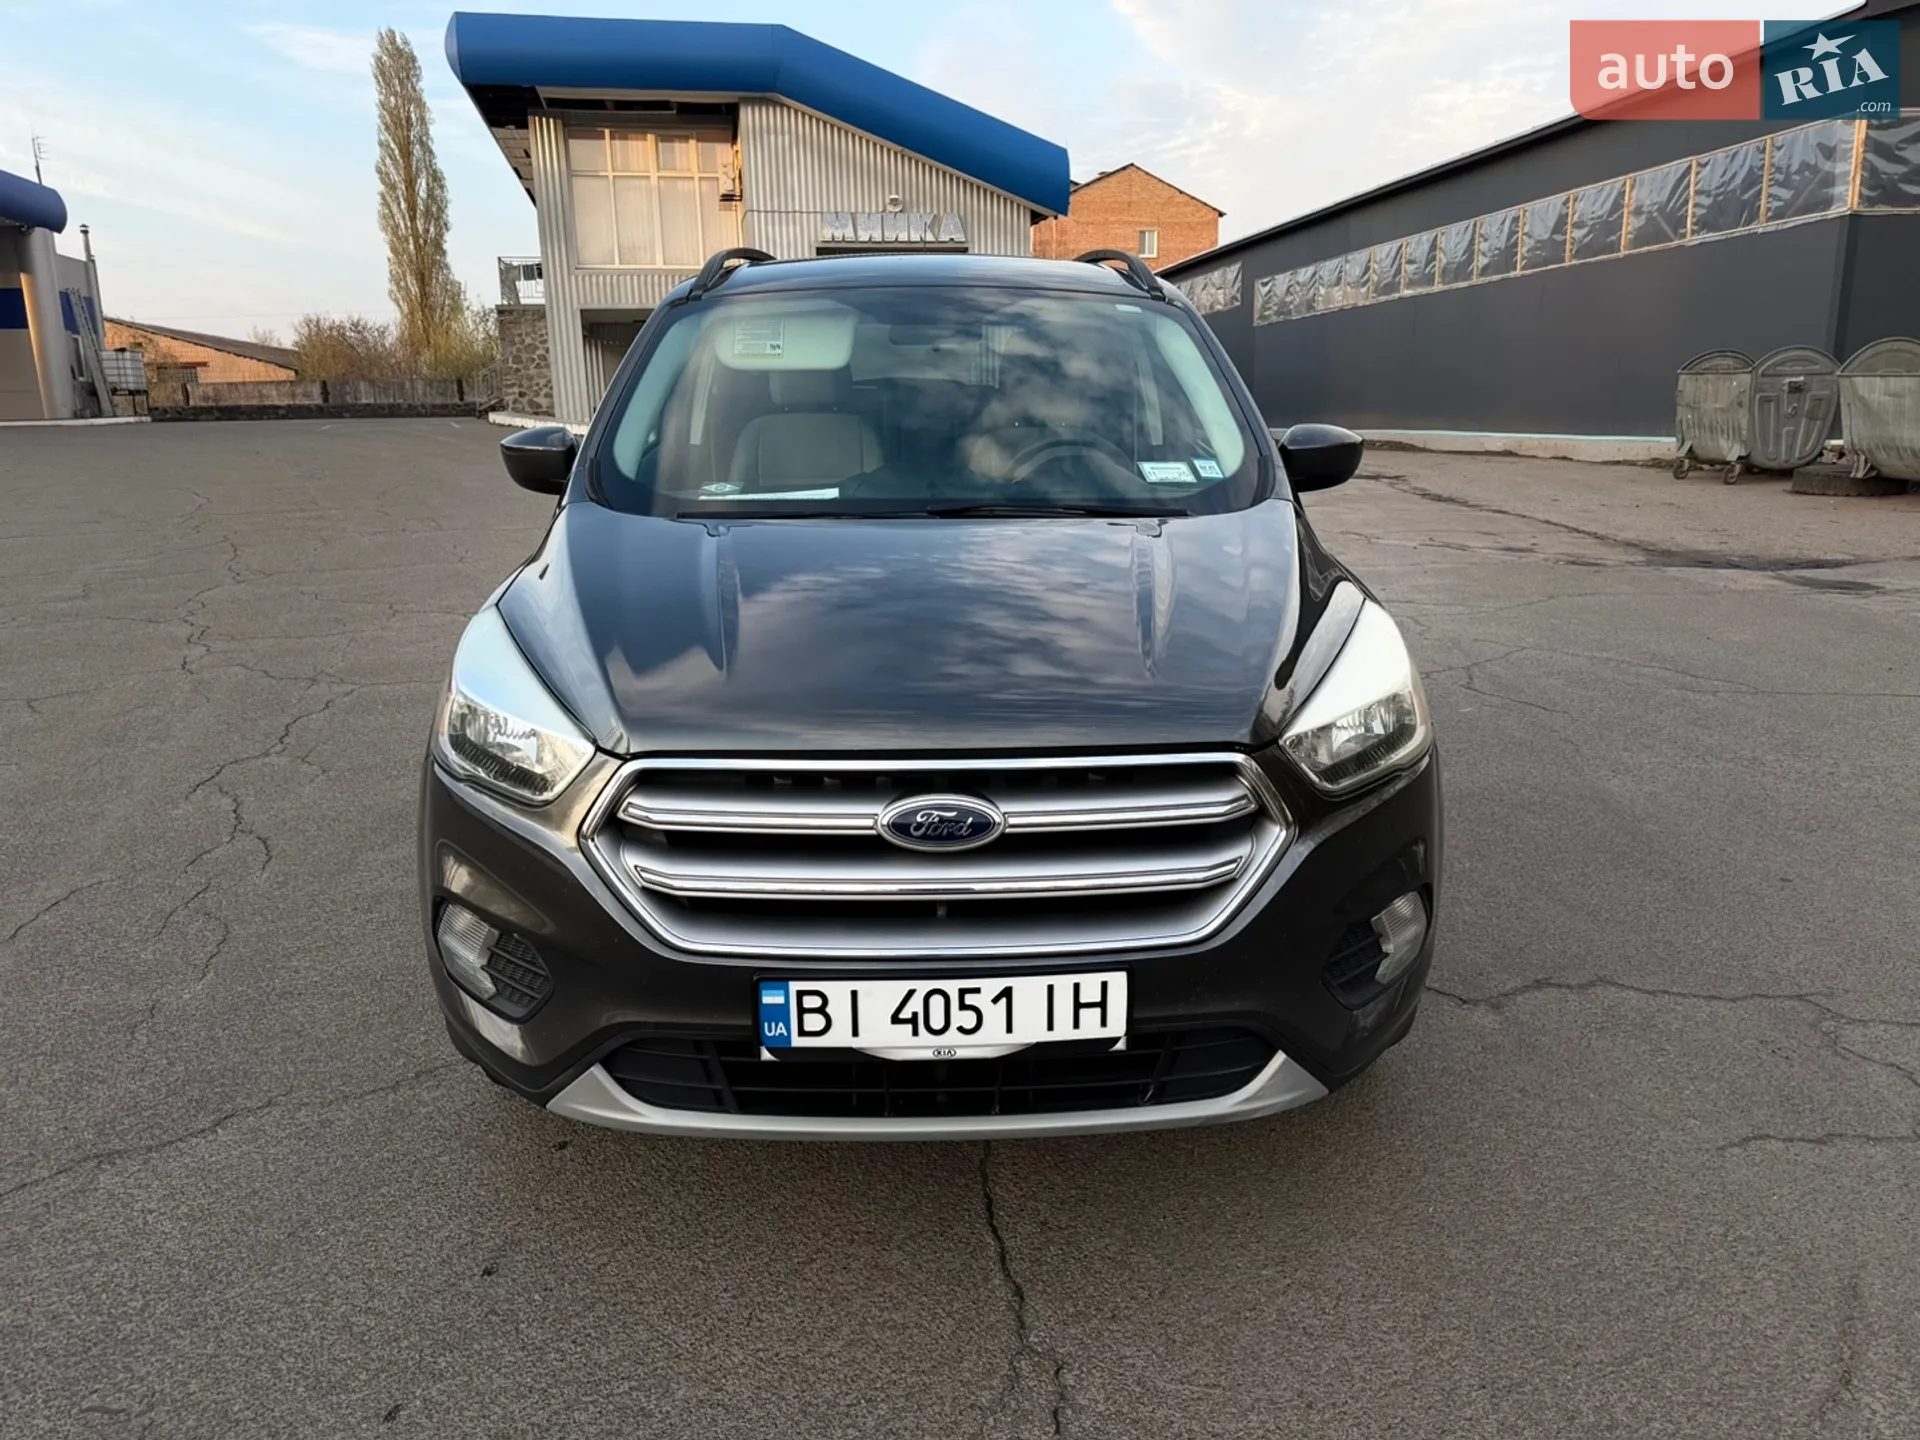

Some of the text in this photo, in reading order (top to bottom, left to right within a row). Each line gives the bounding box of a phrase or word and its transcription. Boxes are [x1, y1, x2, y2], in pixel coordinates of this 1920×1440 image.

[909, 809, 974, 837] Ford
[795, 981, 1108, 1038] BI 4051 IH
[764, 1021, 788, 1038] UA
